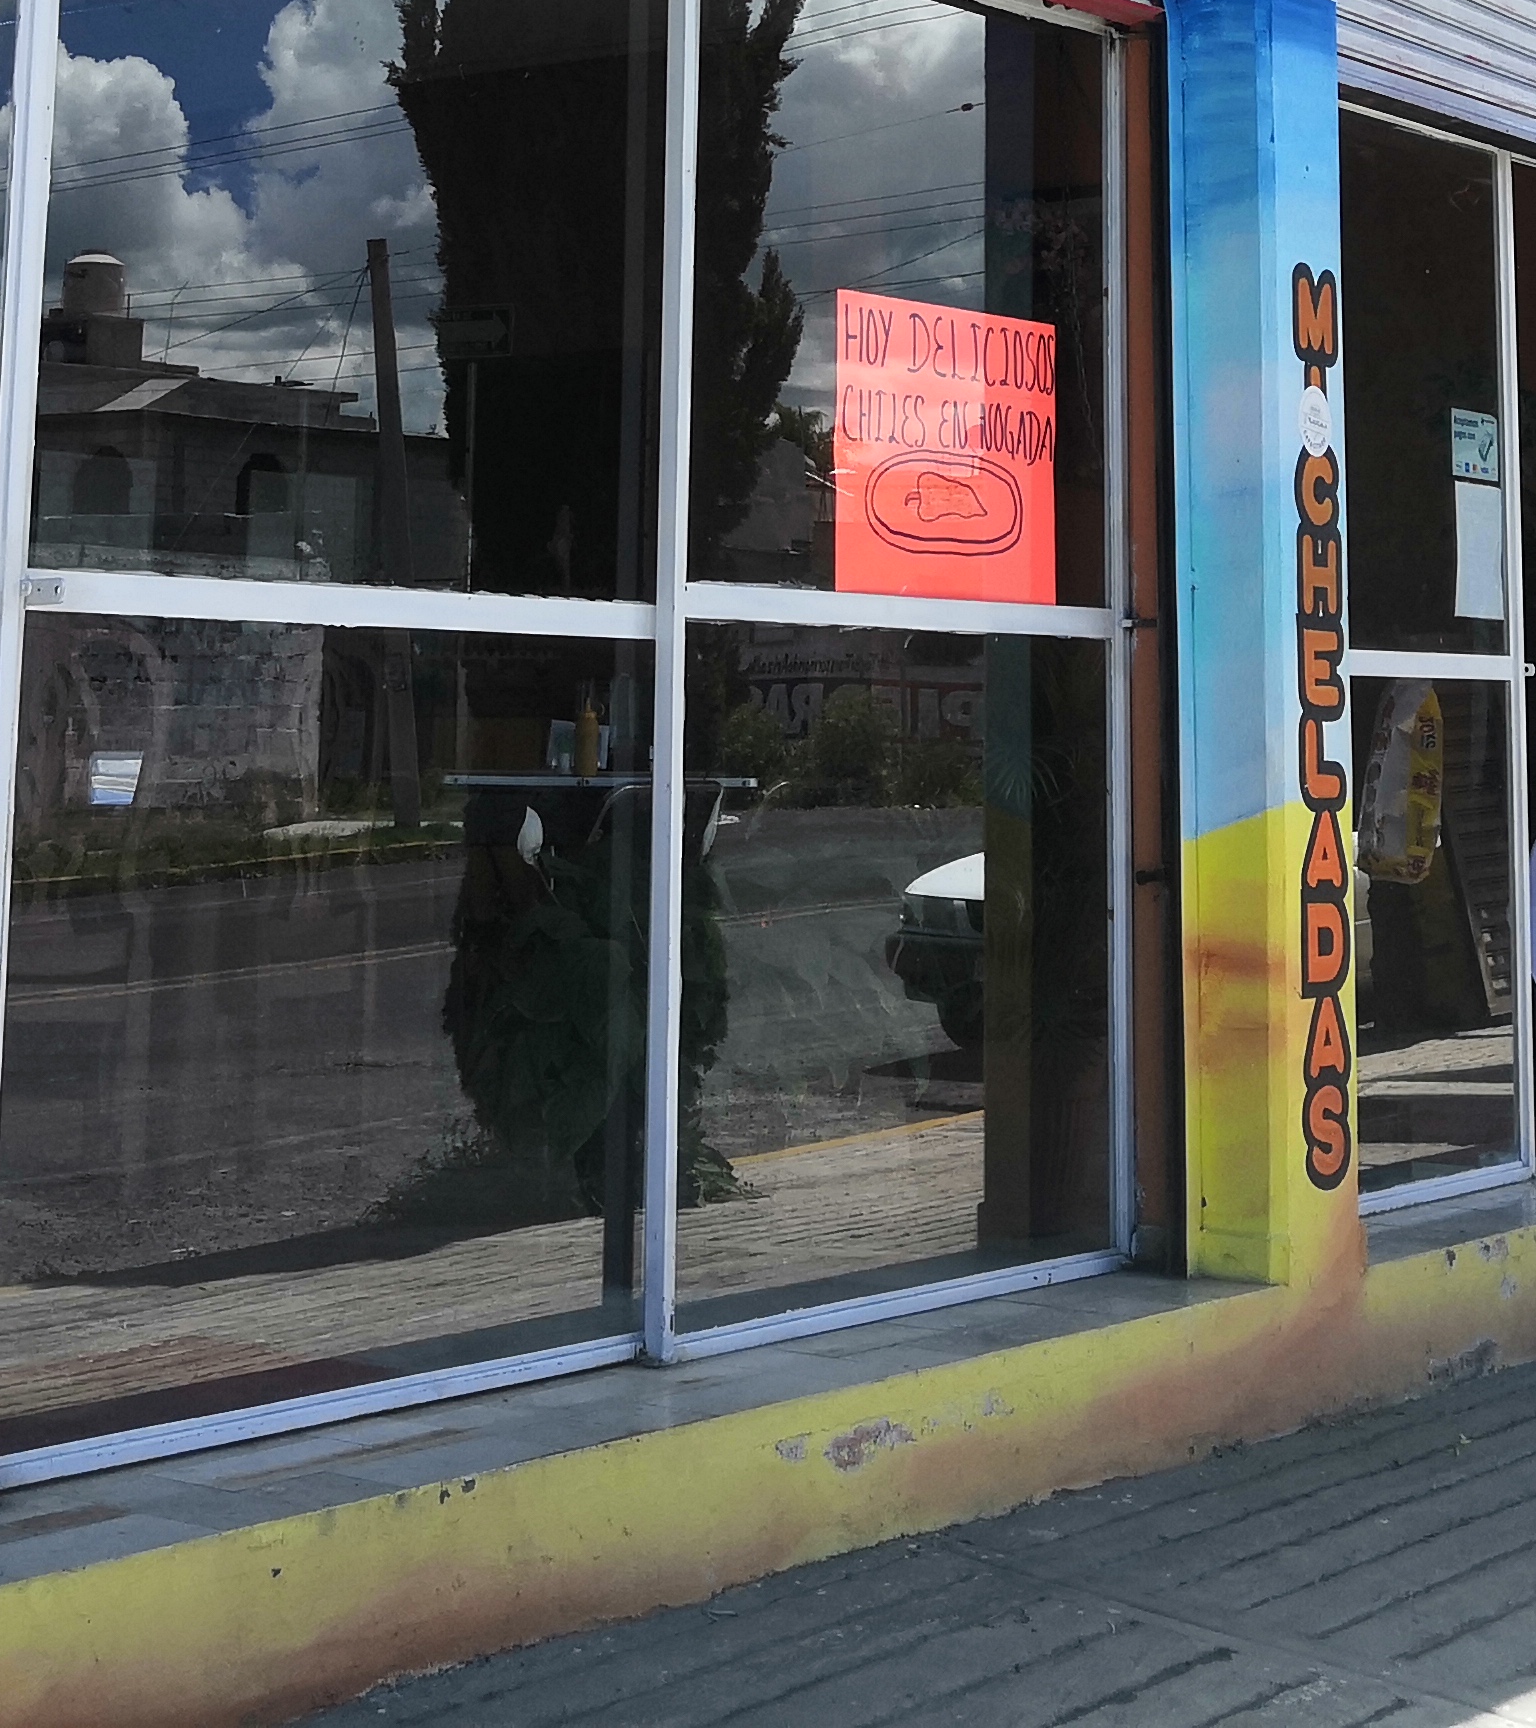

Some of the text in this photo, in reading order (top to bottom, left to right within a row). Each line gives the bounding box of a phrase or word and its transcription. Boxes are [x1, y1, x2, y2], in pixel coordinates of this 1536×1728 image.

[843, 302, 1057, 396] HOY DELICIOSOS
[841, 384, 1055, 467] CHILES EN NOGADA
